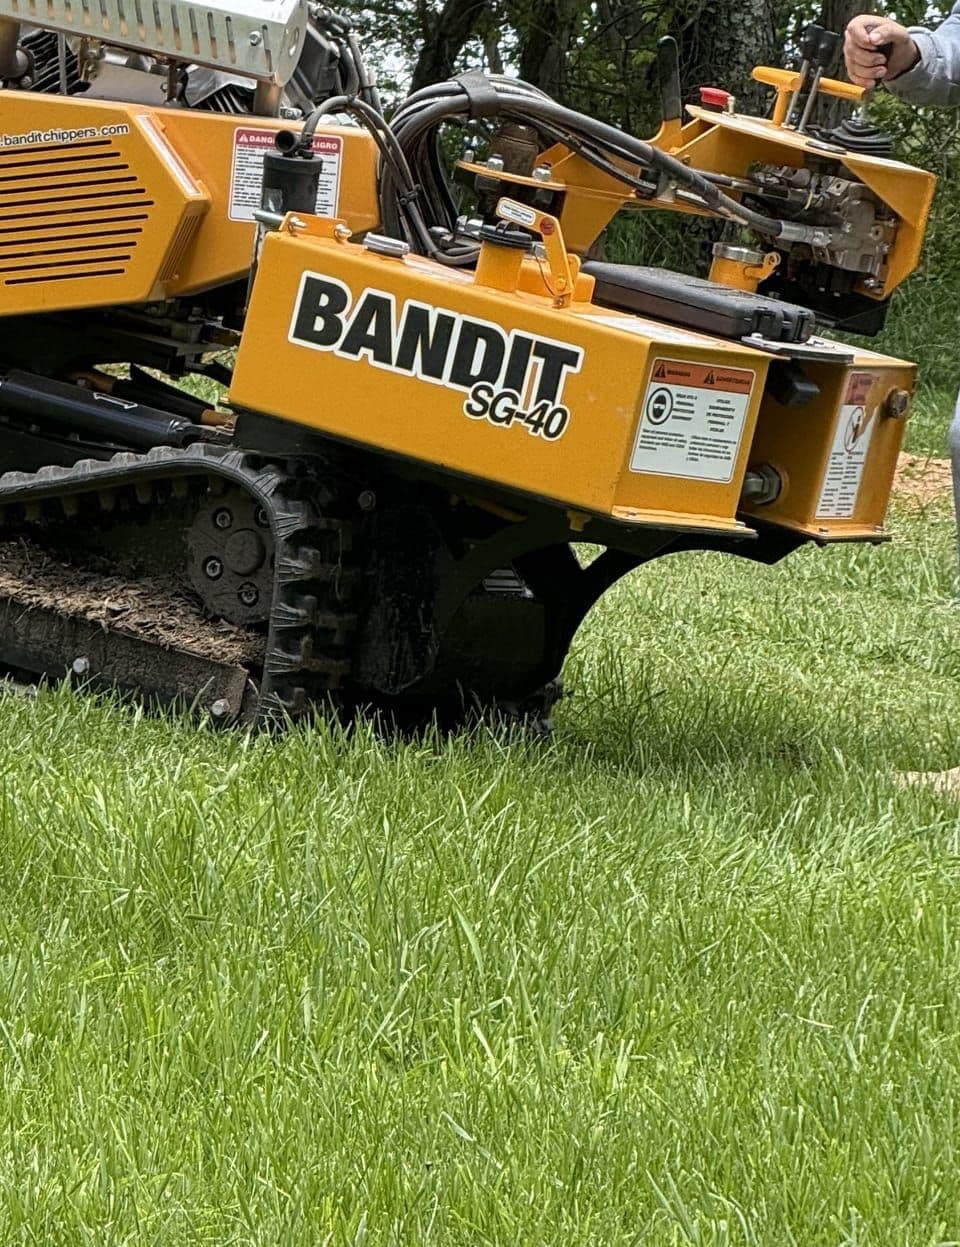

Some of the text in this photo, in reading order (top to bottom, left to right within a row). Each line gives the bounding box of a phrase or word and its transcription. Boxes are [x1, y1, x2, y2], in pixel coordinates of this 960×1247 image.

[249, 135, 275, 144] DANG
[312, 140, 338, 150] LIGRO
[290, 273, 582, 408] BANDIT
[465, 384, 569, 439] SG-40
